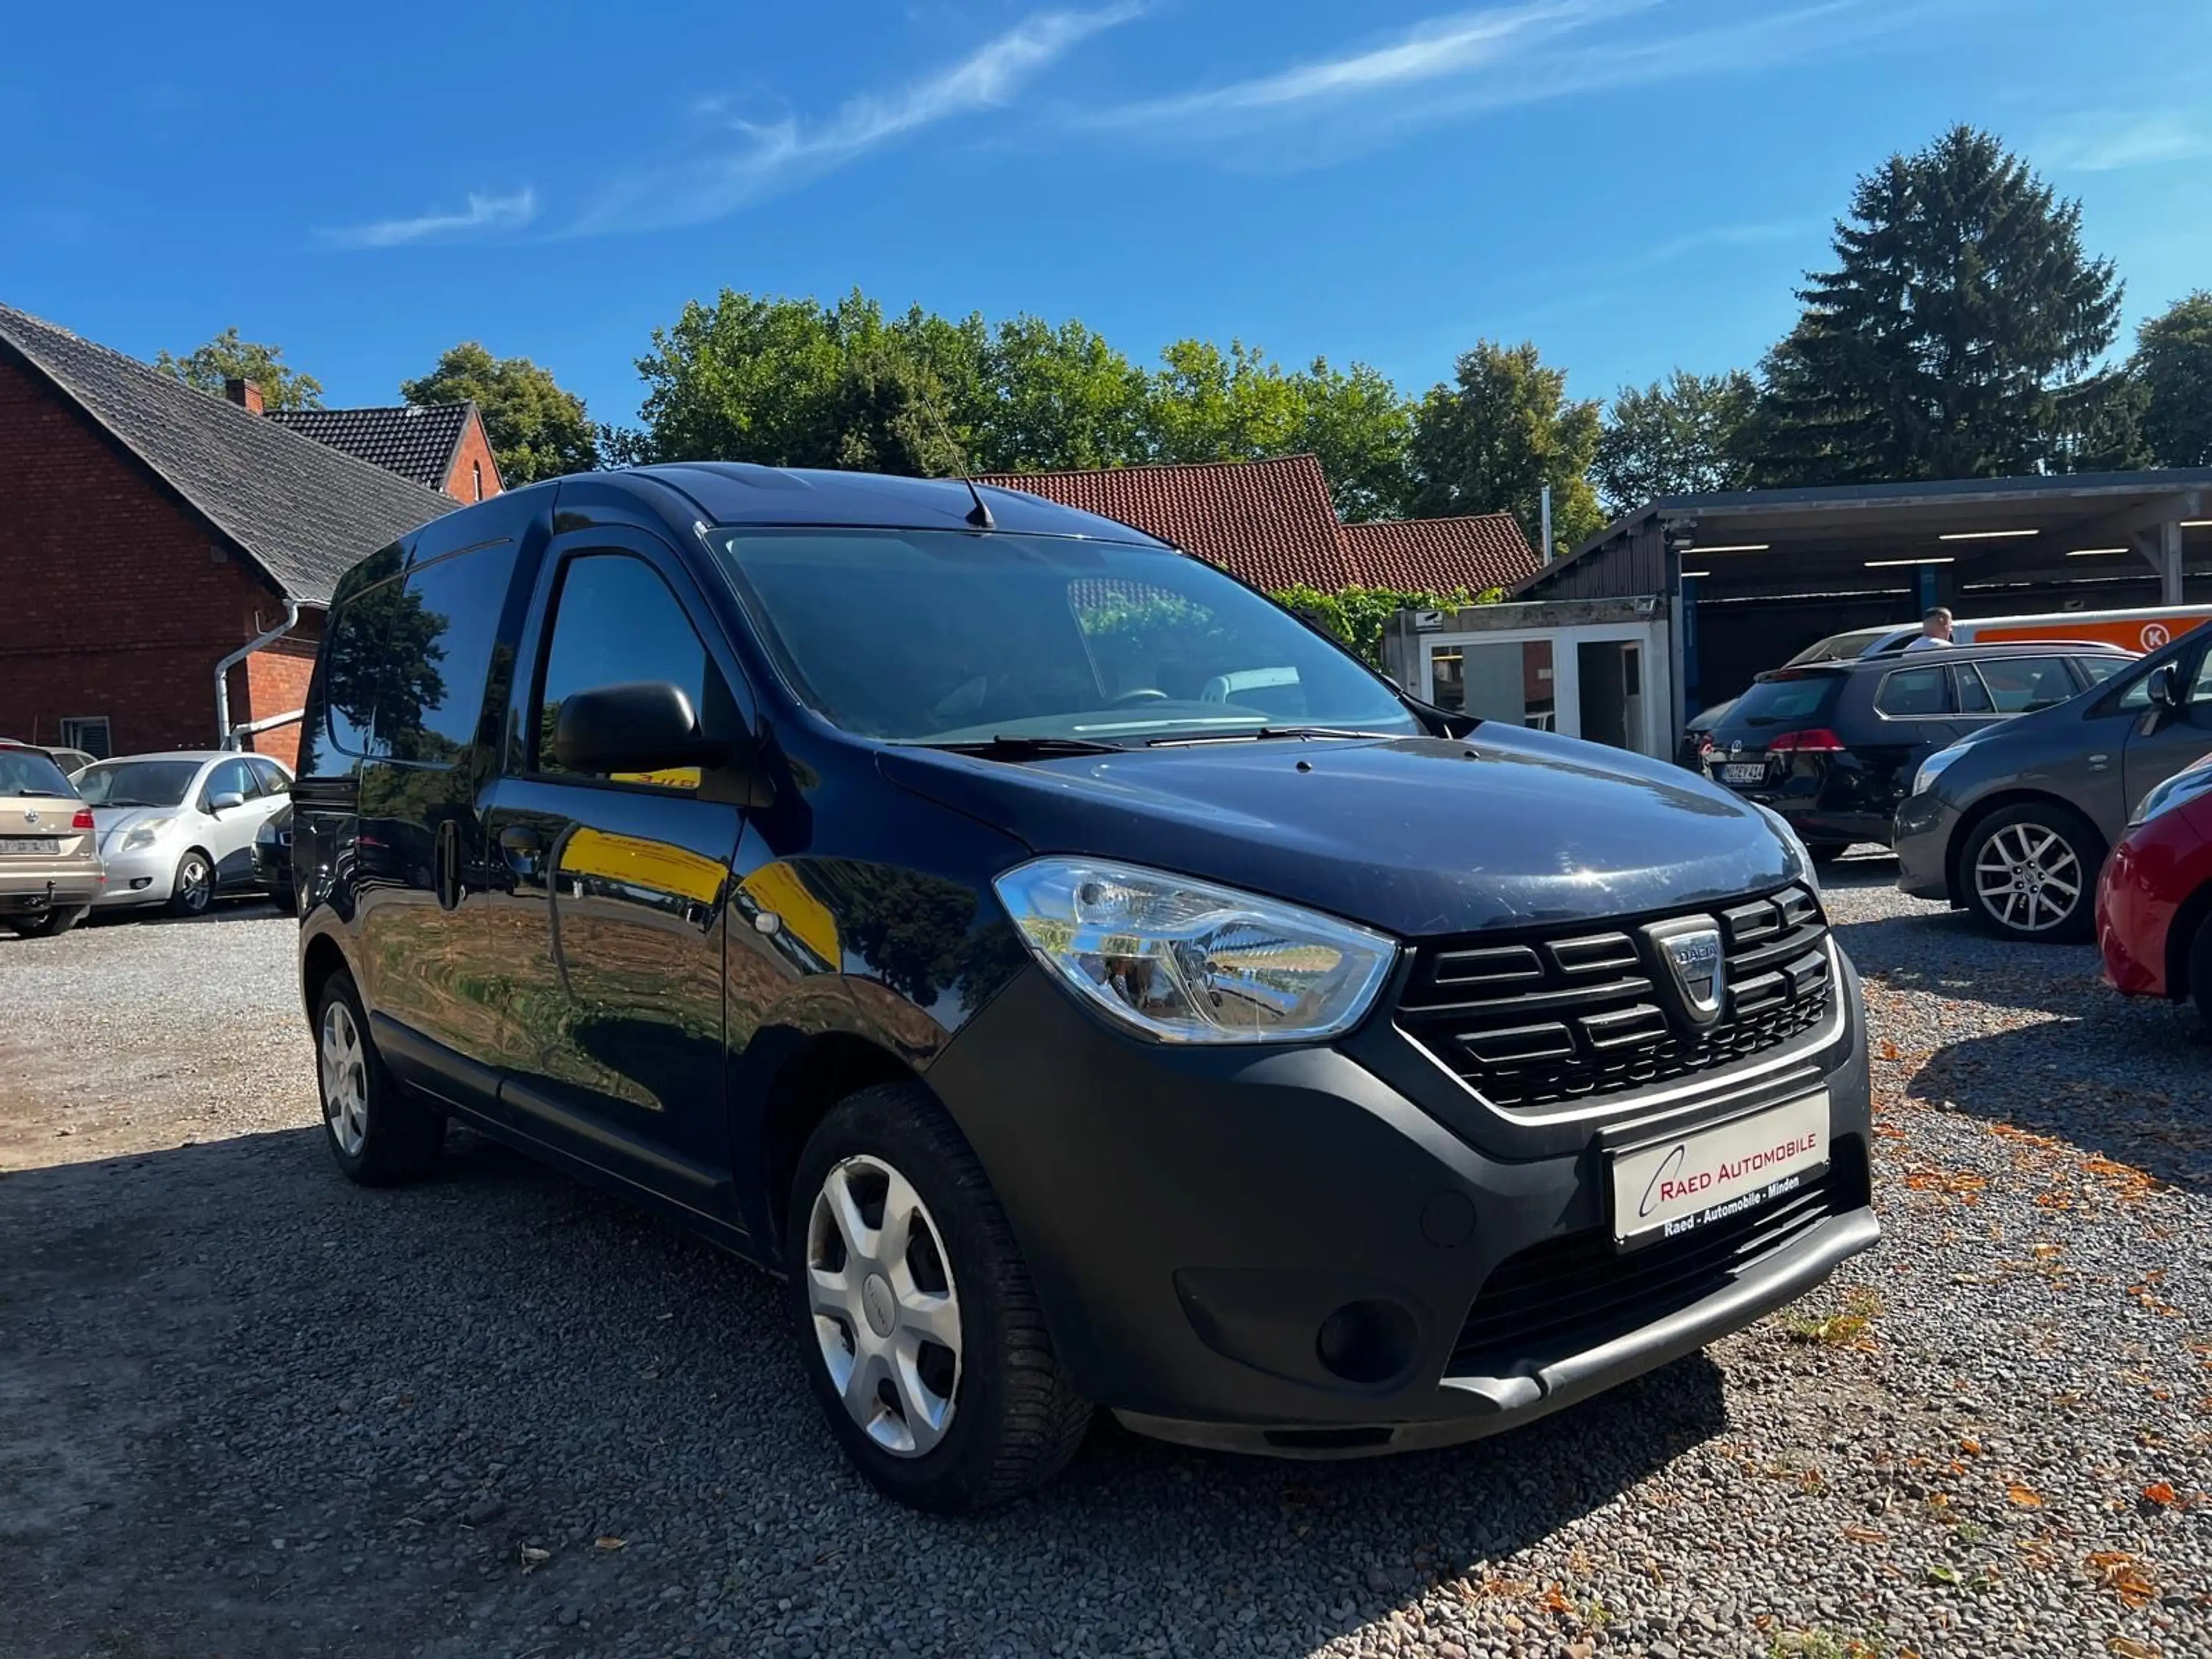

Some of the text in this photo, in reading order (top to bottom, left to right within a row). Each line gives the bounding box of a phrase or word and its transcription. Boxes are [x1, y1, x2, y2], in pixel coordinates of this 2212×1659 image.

[2149, 630, 2162, 646] K
[1660, 1133, 1816, 1202] RAED AUTOMOBILE
[1664, 1214, 1695, 1238] Raed
[1703, 1192, 1761, 1224] Automobile
[1767, 1176, 1800, 1199] Minden
